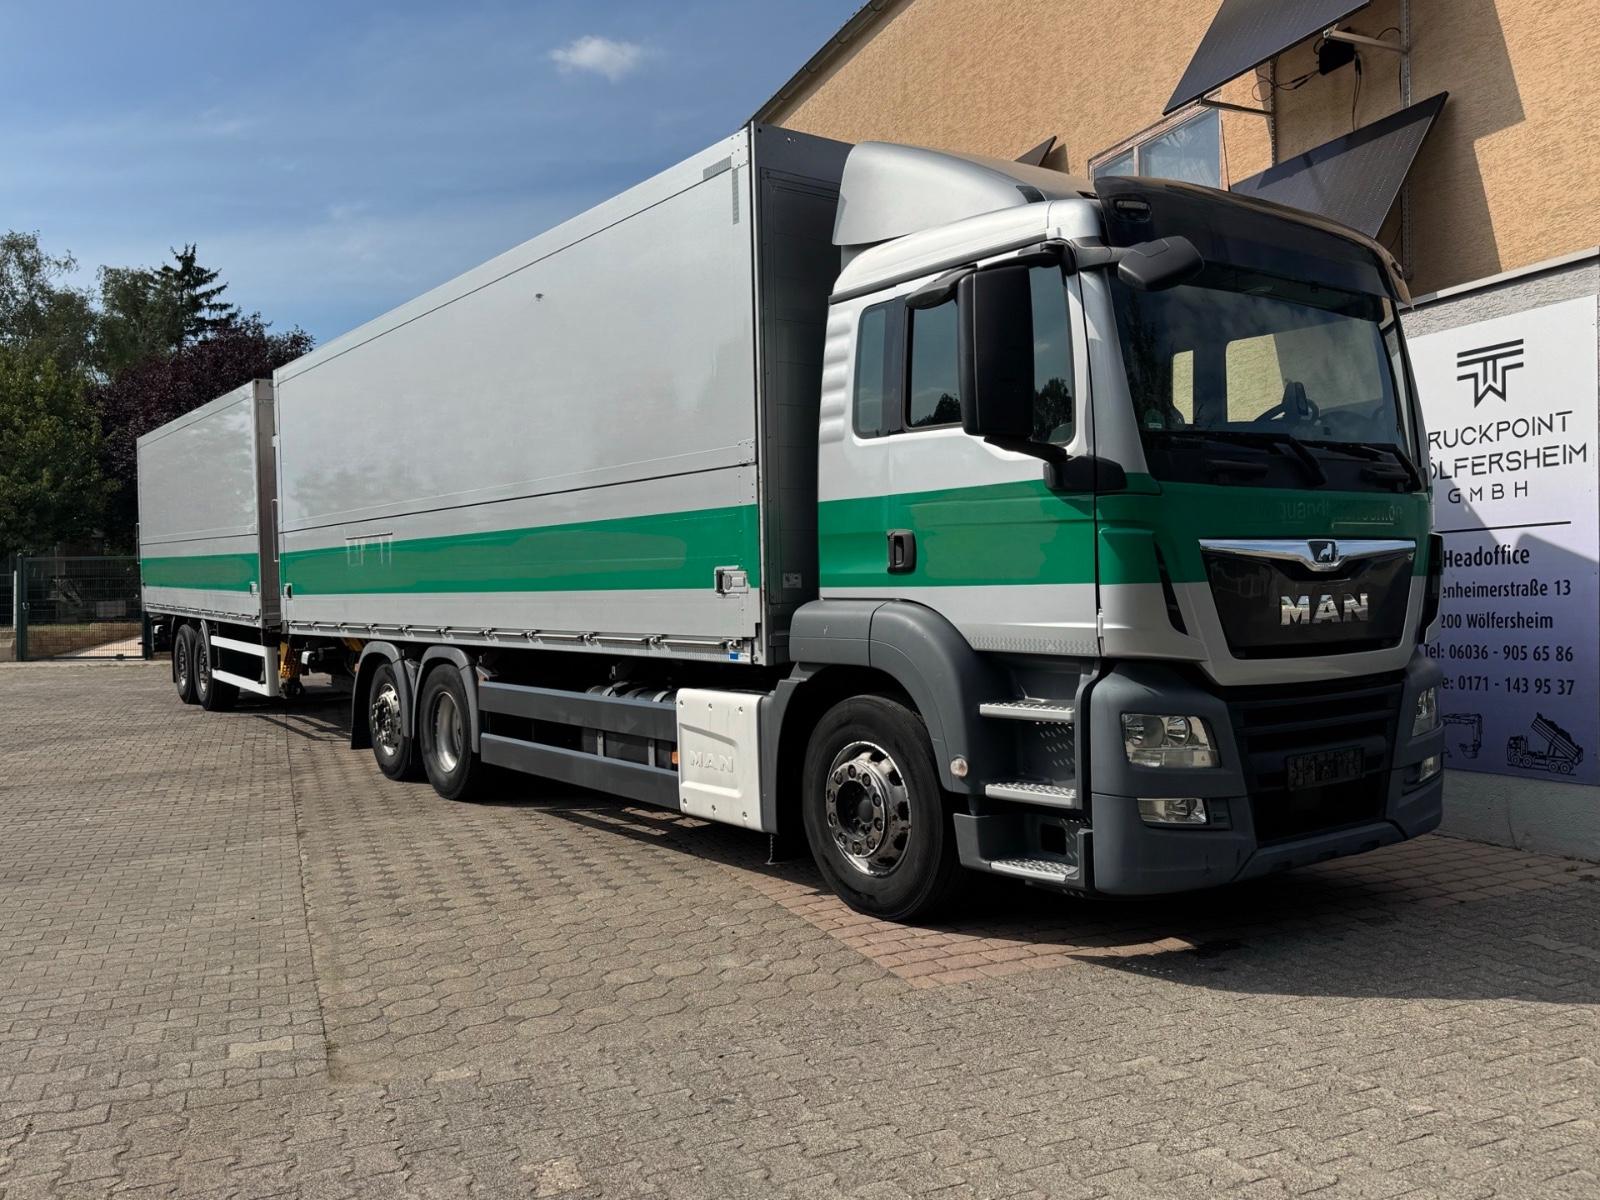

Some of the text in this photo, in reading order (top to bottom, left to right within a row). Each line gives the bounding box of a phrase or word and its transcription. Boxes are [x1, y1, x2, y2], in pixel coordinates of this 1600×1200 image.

[1428, 410, 1573, 451] RUCKPOINT
[1443, 545, 1530, 568] Headoffice
[1554, 579, 1571, 596] 13
[1280, 593, 1369, 626] MAN
[1466, 611, 1553, 629] Wölfersheim
[1424, 642, 1445, 659] Tel:
[1449, 644, 1489, 660] 06036
[1503, 644, 1528, 661] 905
[1533, 645, 1550, 662] 65
[1555, 645, 1574, 662] 86
[1458, 674, 1489, 692] 0171
[1504, 676, 1529, 694] 143
[1534, 678, 1551, 695] 95
[1557, 678, 1575, 696] 37
[687, 749, 735, 775] MAN
